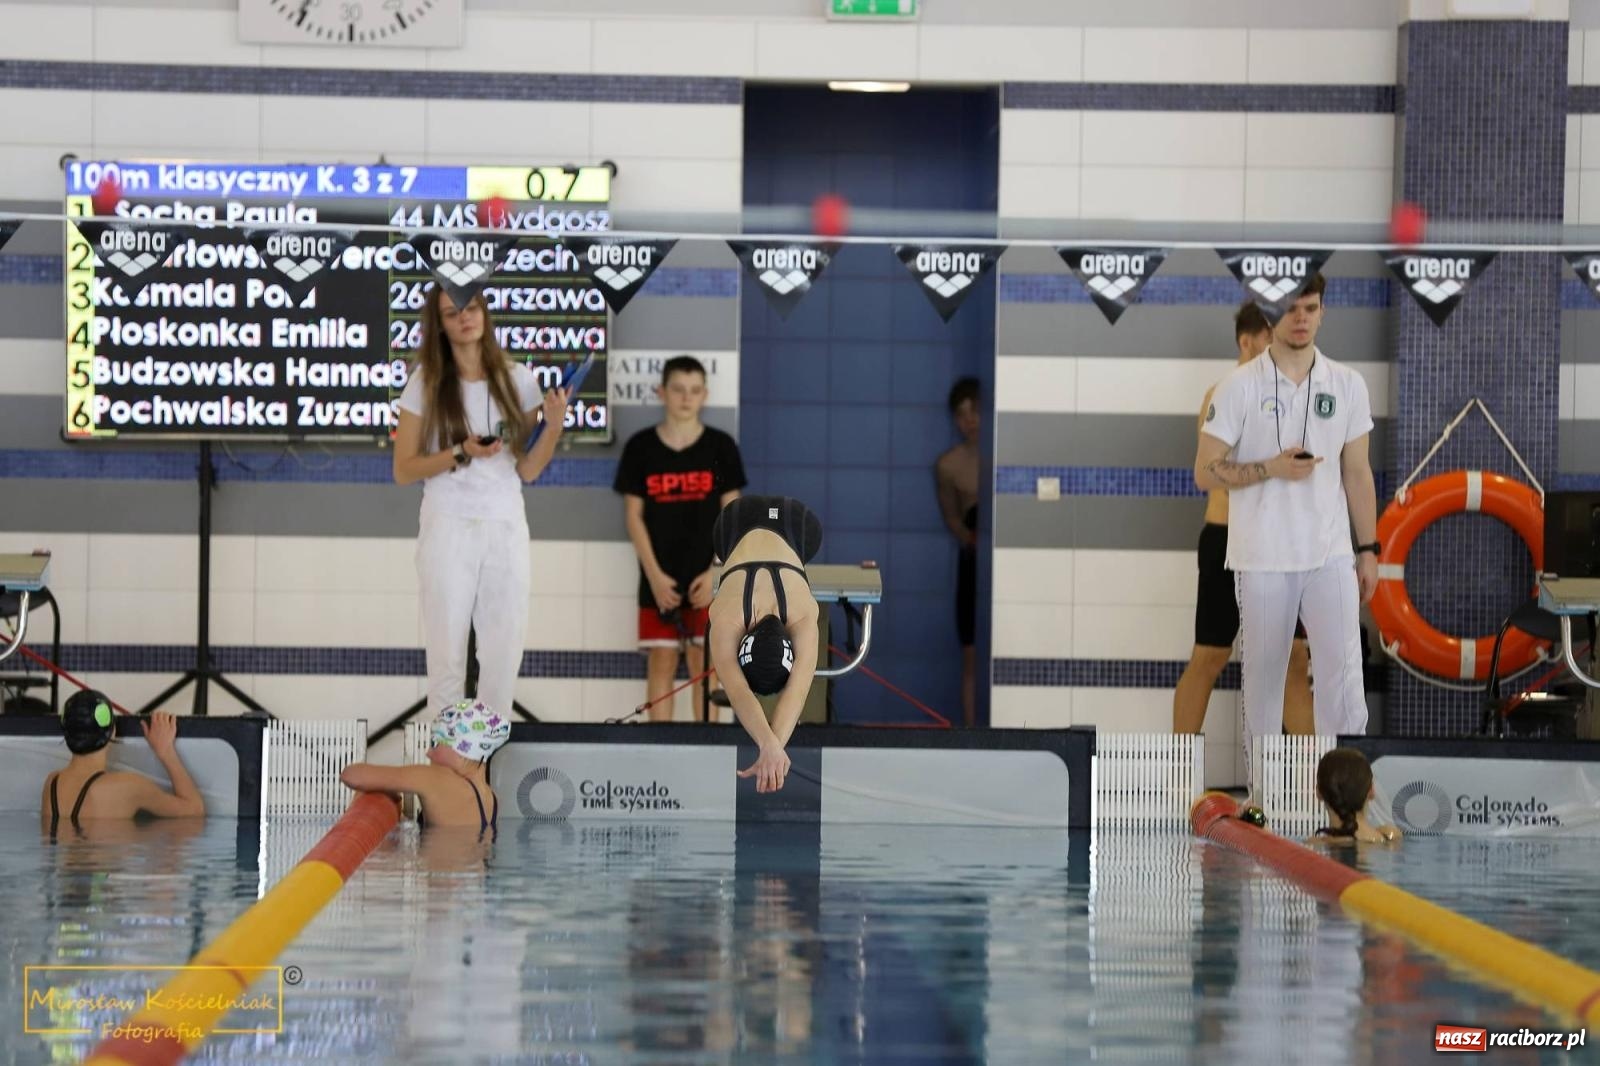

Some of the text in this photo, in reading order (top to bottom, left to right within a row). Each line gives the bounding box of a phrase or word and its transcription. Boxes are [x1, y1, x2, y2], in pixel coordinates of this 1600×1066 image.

[70, 163, 418, 199] 100m klasyczny K. 3 z 7
[526, 168, 580, 200] 0.7
[115, 200, 216, 228] Socha
[226, 201, 318, 225] Paula
[389, 204, 424, 228] 44
[432, 205, 478, 229] MS
[100, 230, 166, 252] arena
[266, 235, 332, 257] arena
[429, 240, 494, 262] arena
[71, 242, 91, 271] 2
[587, 243, 651, 266] arena
[752, 246, 817, 270] arena
[915, 250, 980, 273] arena
[1080, 252, 1145, 275] arena
[1241, 255, 1307, 277] arena
[1404, 256, 1471, 279] arena
[72, 282, 91, 310] 3
[482, 287, 605, 311] arszawa
[71, 322, 90, 350] 4
[72, 356, 391, 388] 5 Budzowska Hanna
[72, 400, 90, 428] 6
[94, 395, 288, 426] Pochwalska
[581, 797, 614, 810] TIME
[1458, 812, 1490, 824] TIME
